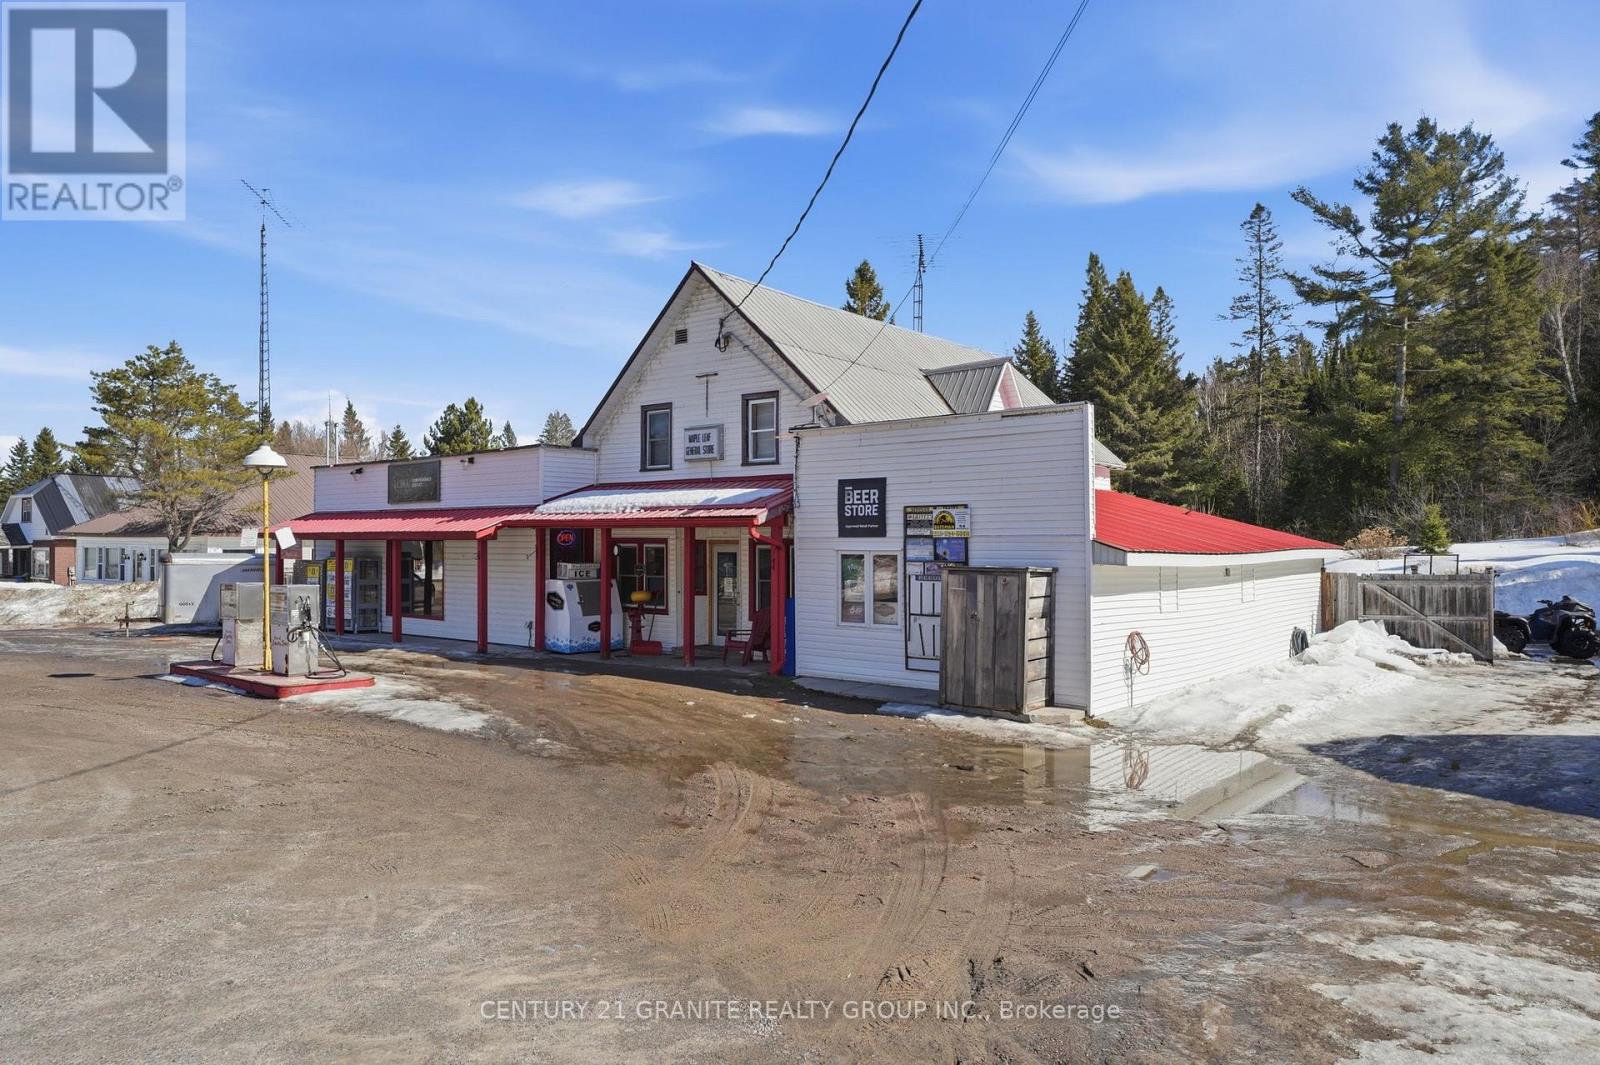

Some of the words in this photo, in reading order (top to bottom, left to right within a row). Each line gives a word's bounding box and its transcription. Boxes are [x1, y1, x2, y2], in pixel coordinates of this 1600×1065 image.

[844, 489, 879, 504] BEER
[844, 504, 879, 516] STORE
[574, 569, 591, 578] ICE
